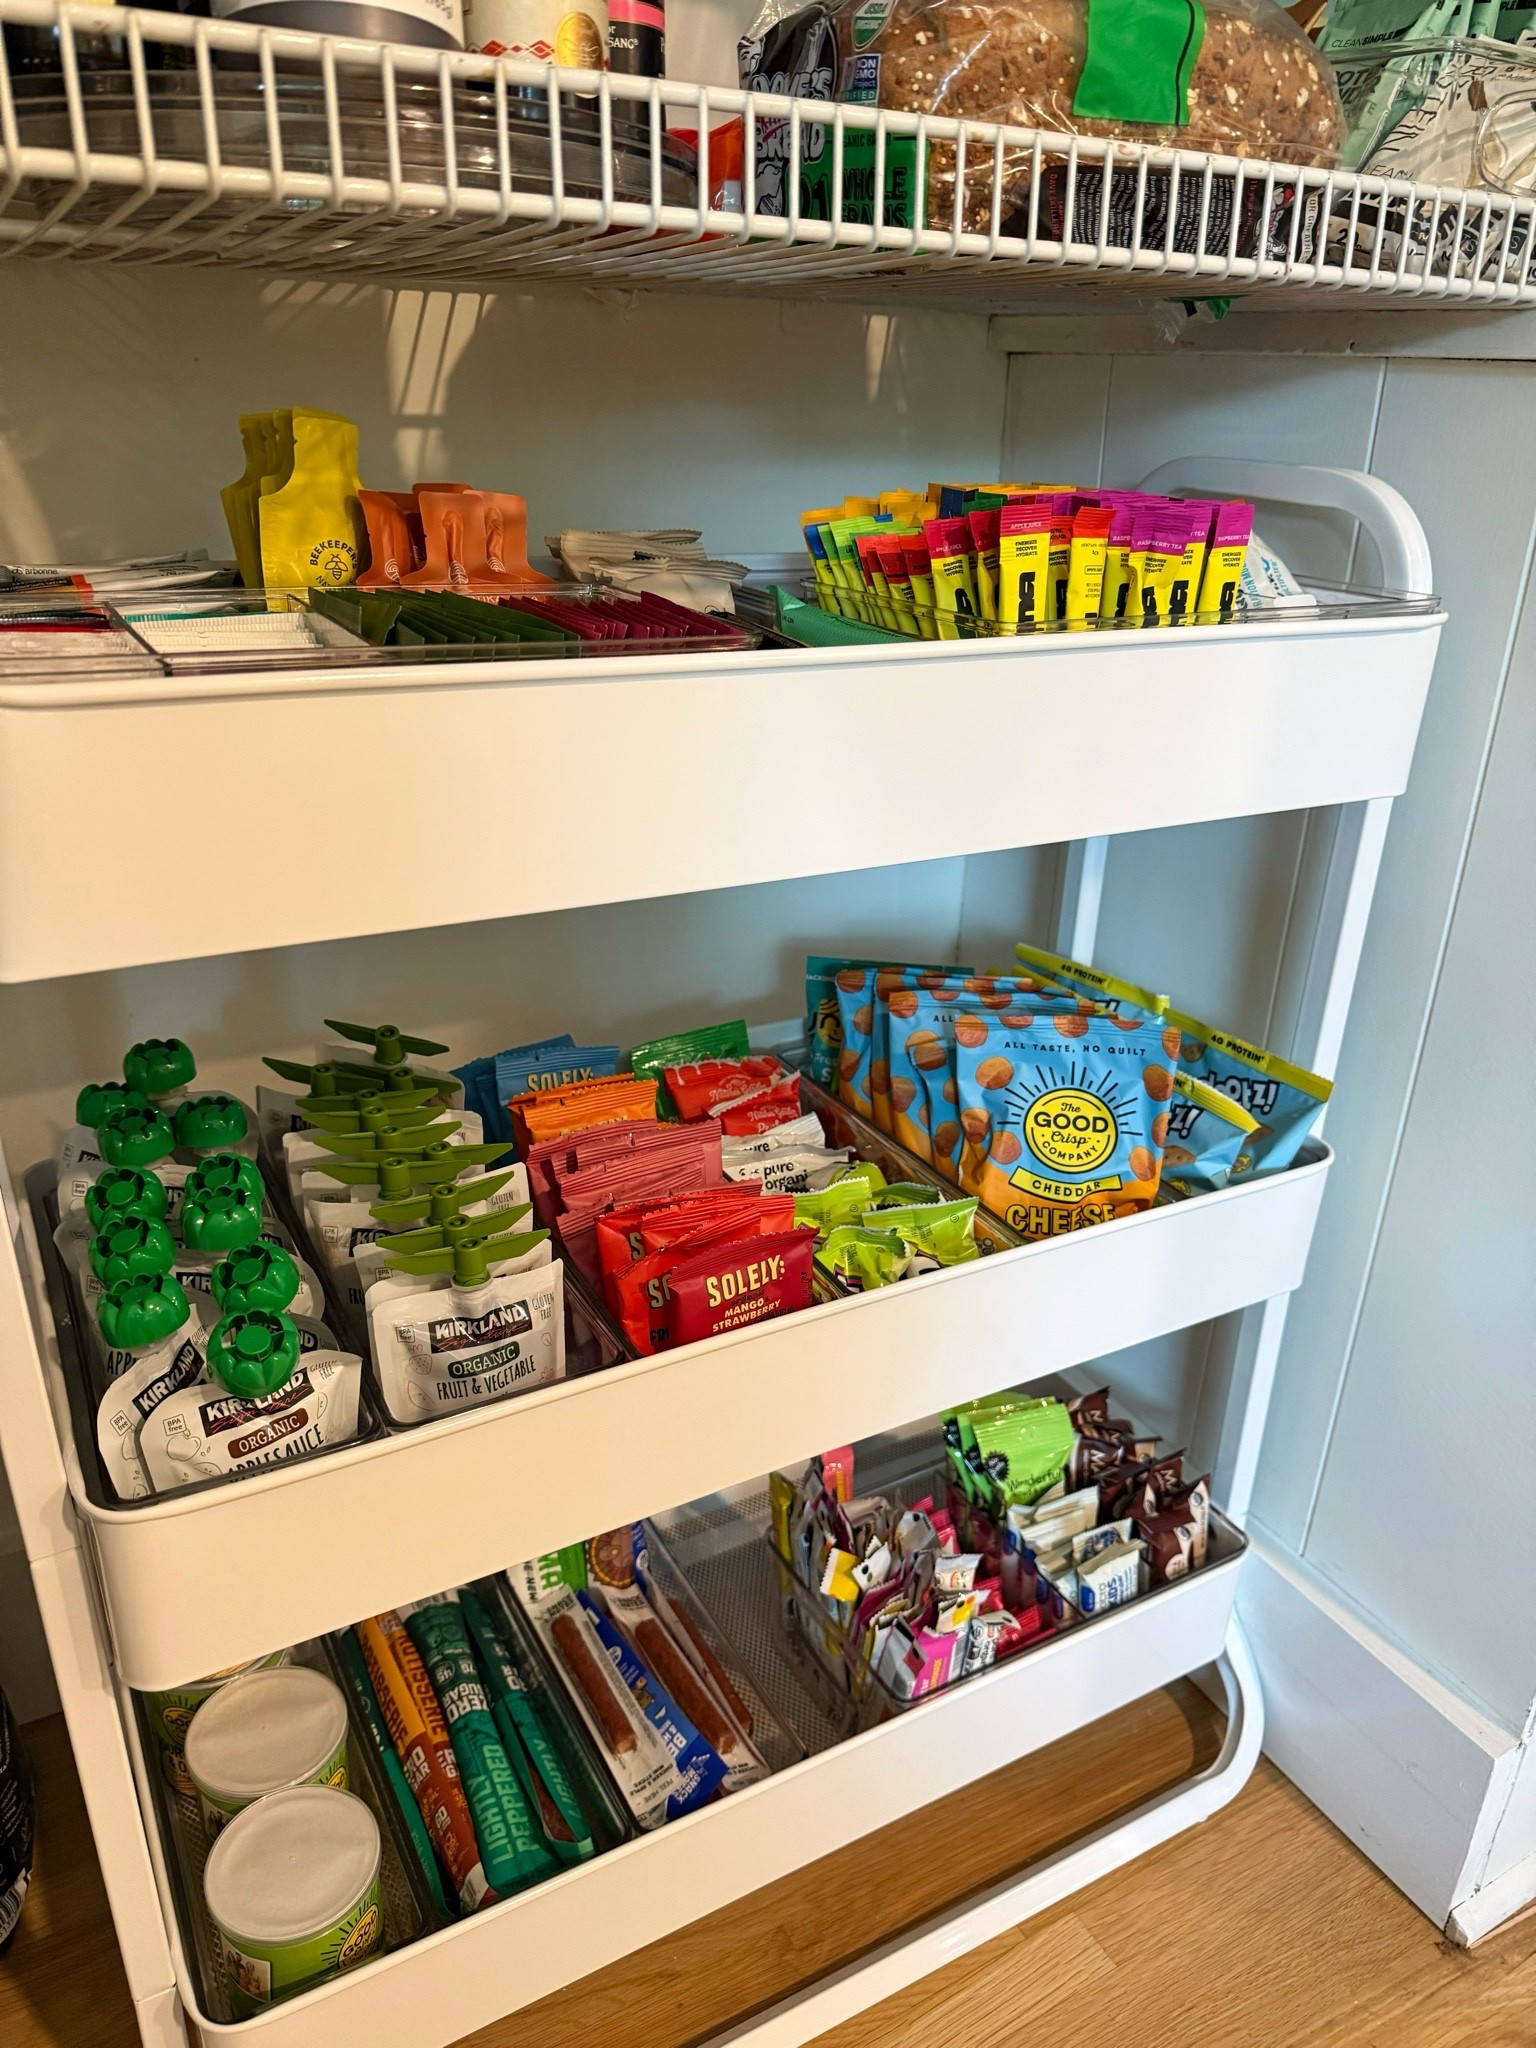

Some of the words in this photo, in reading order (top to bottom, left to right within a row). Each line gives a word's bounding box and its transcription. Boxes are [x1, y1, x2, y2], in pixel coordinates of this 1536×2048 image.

[841, 203, 908, 228] GRANS
[1137, 540, 1171, 549] RASPBERRY
[1004, 1041, 1026, 1050] ALL
[1033, 1043, 1076, 1053] TASTE,
[1083, 1045, 1100, 1053] NO
[1061, 1102, 1082, 1113] The
[1034, 1112, 1109, 1134] GOOD
[1051, 1130, 1088, 1147] Crisp
[1042, 1140, 1100, 1161] COMPANY
[763, 1162, 795, 1177] pure
[764, 1169, 809, 1191] organi
[1032, 1179, 1102, 1198] CHEDDAR
[1004, 1203, 1117, 1236] CHEESE
[531, 1291, 555, 1310] GLUTEN
[724, 1299, 765, 1319] MANGO
[435, 1304, 529, 1340] KIRKLAND
[712, 1299, 782, 1333] STRAWBERRY
[452, 1345, 517, 1376] ORGANIC
[138, 1345, 196, 1414] KIRKLAND
[436, 1379, 470, 1401] FRUIT
[471, 1373, 483, 1395] &
[481, 1354, 537, 1394] VEGETABLE
[206, 1371, 304, 1422] KIRKLAND
[167, 1416, 183, 1427] BPA
[168, 1423, 184, 1433] free
[238, 1414, 301, 1453] ORGANIC
[446, 1693, 490, 1724] ZERO
[482, 1743, 540, 1853] PEPPERED
[468, 1774, 515, 1866] LIGHTLY
